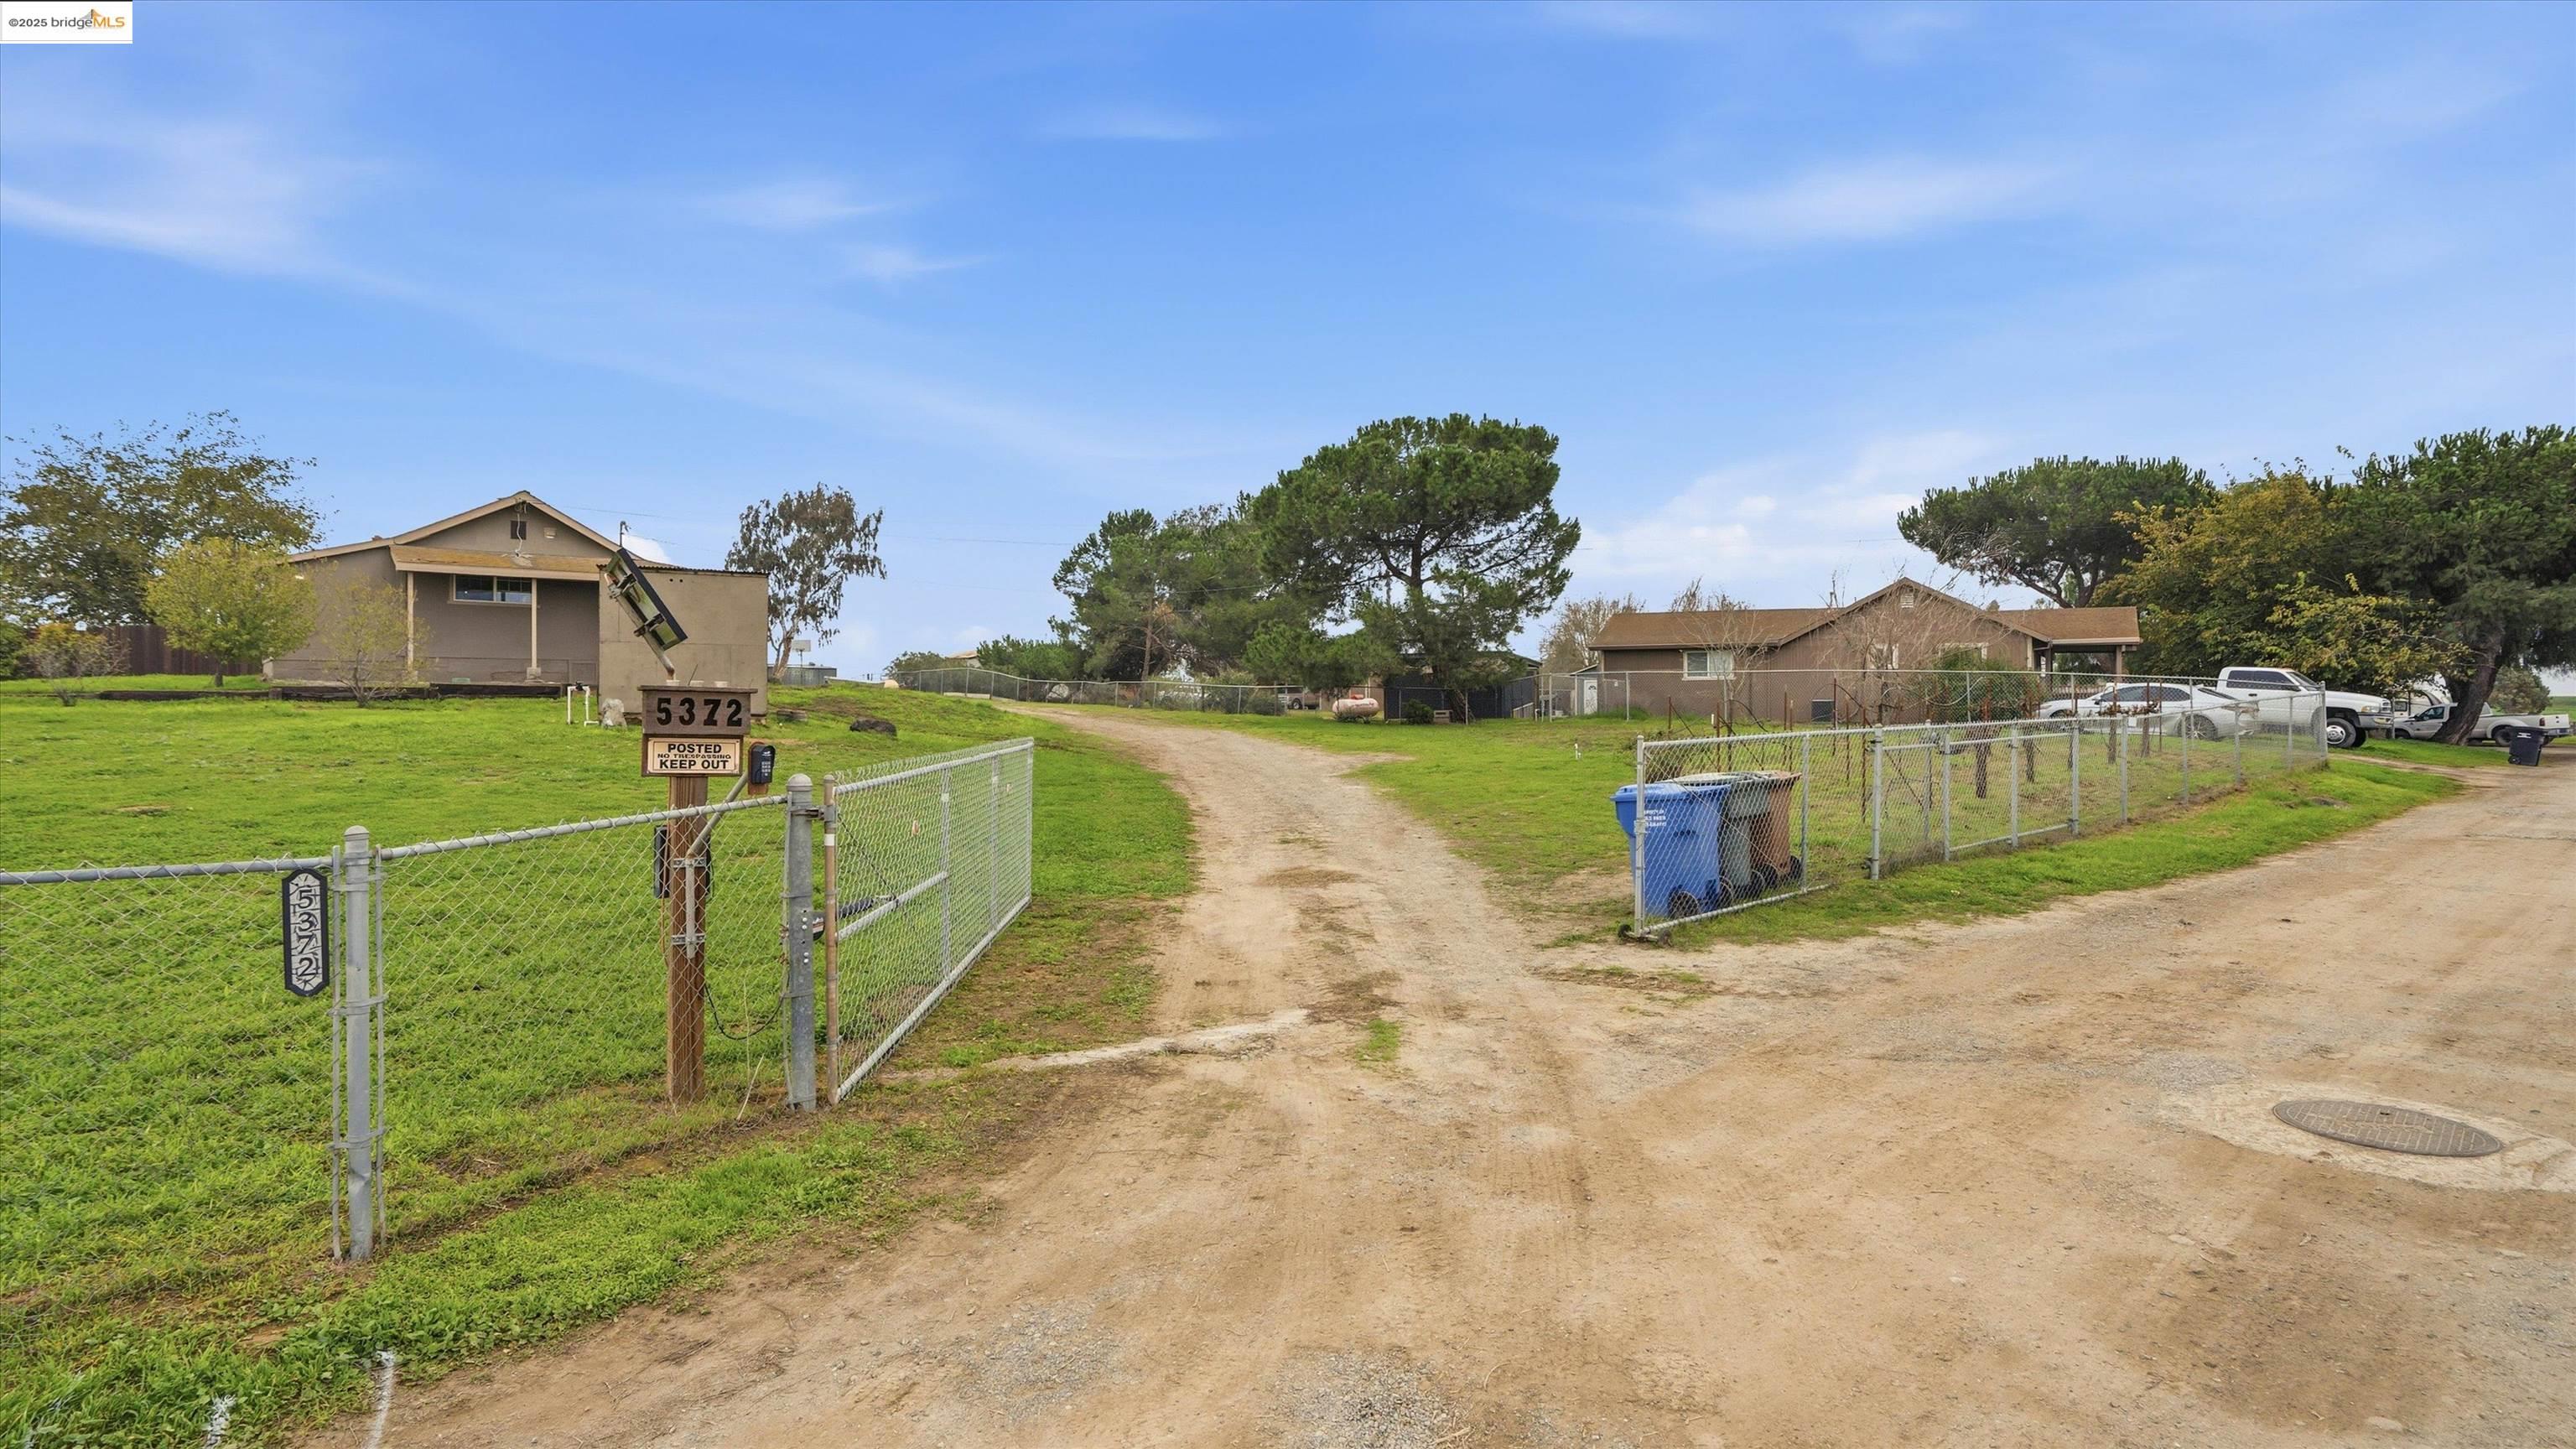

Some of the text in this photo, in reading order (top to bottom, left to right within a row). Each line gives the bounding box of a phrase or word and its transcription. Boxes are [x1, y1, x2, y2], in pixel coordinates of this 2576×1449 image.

[657, 697, 742, 727] 5372
[667, 744, 721, 753] POSTED
[660, 760, 729, 769] KEEP OUT
[298, 890, 316, 977] 5372
